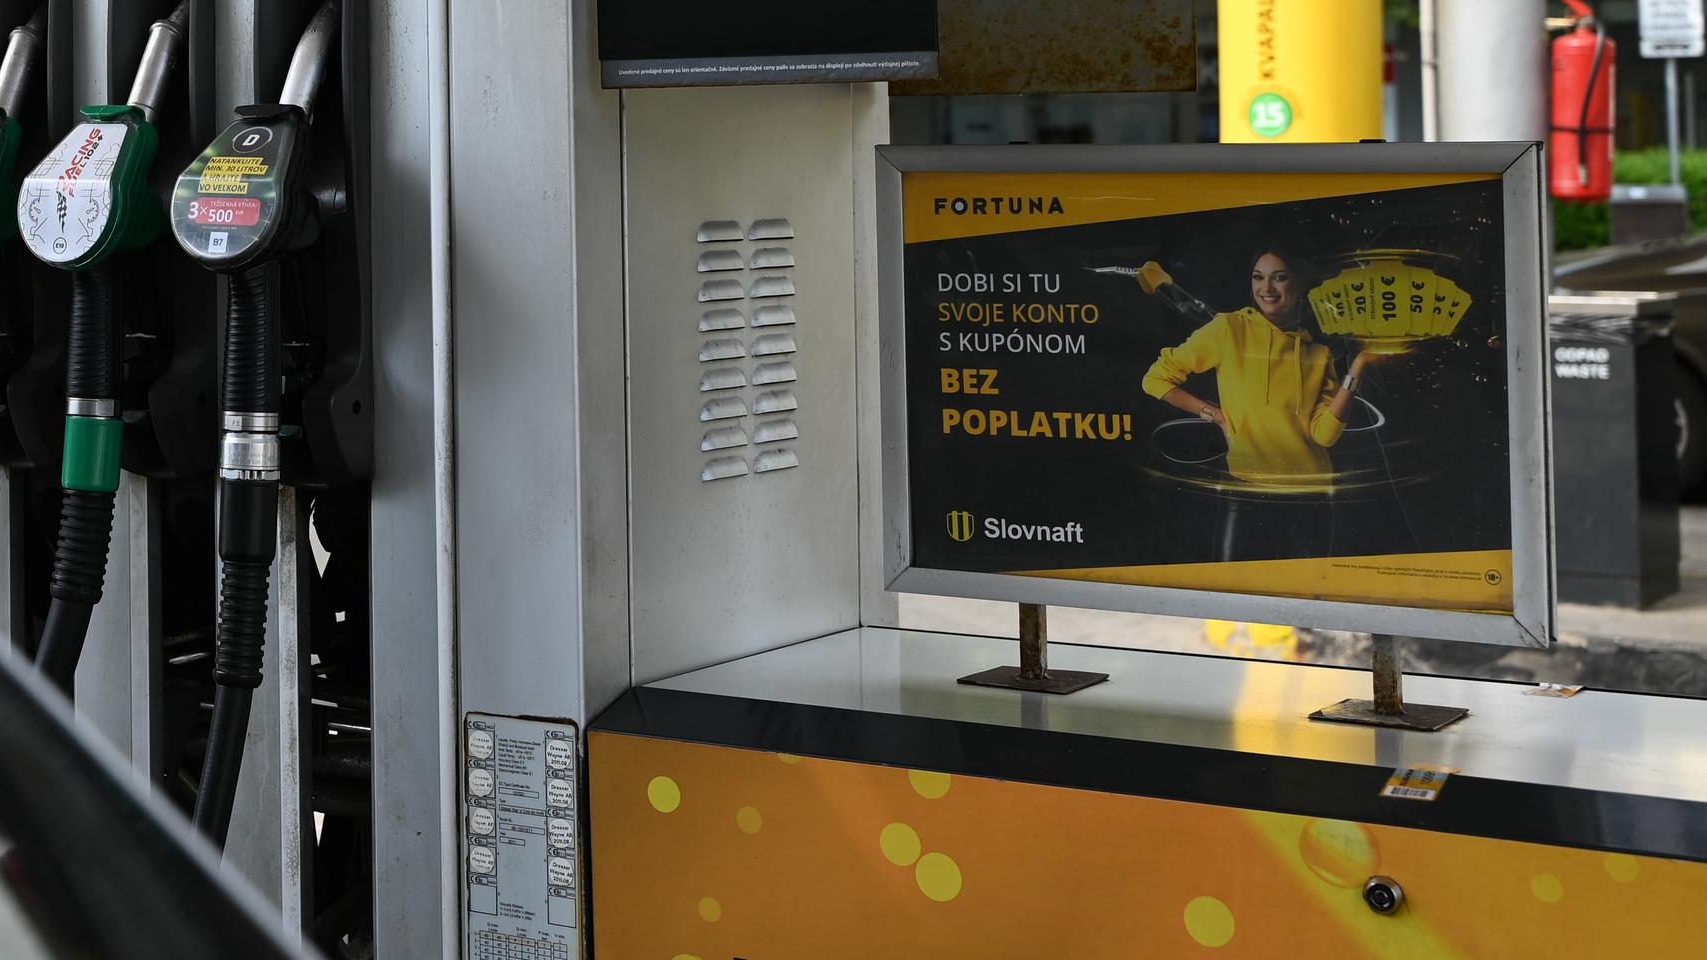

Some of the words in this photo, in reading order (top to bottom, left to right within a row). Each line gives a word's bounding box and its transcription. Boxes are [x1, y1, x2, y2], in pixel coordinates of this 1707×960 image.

[1253, 102, 1286, 129] 15
[242, 134, 260, 146] D
[934, 197, 1065, 215] FORTUNA
[938, 272, 994, 292] DOBI
[1002, 273, 1021, 293] SI
[1029, 273, 1061, 293] TU
[1351, 282, 1364, 292] €
[1381, 276, 1395, 286] €
[1412, 281, 1425, 290] €
[938, 303, 1004, 327] SVOJE
[1013, 303, 1099, 324] KONTO
[1355, 295, 1367, 315] 20
[1382, 291, 1397, 322] 100
[1410, 295, 1424, 314] 50
[940, 332, 951, 352] S
[959, 329, 1086, 354] KUPÓNOM
[940, 368, 999, 395] BEZ
[942, 408, 1132, 441] POPLATKU!
[984, 517, 1084, 543] Slovnaft
